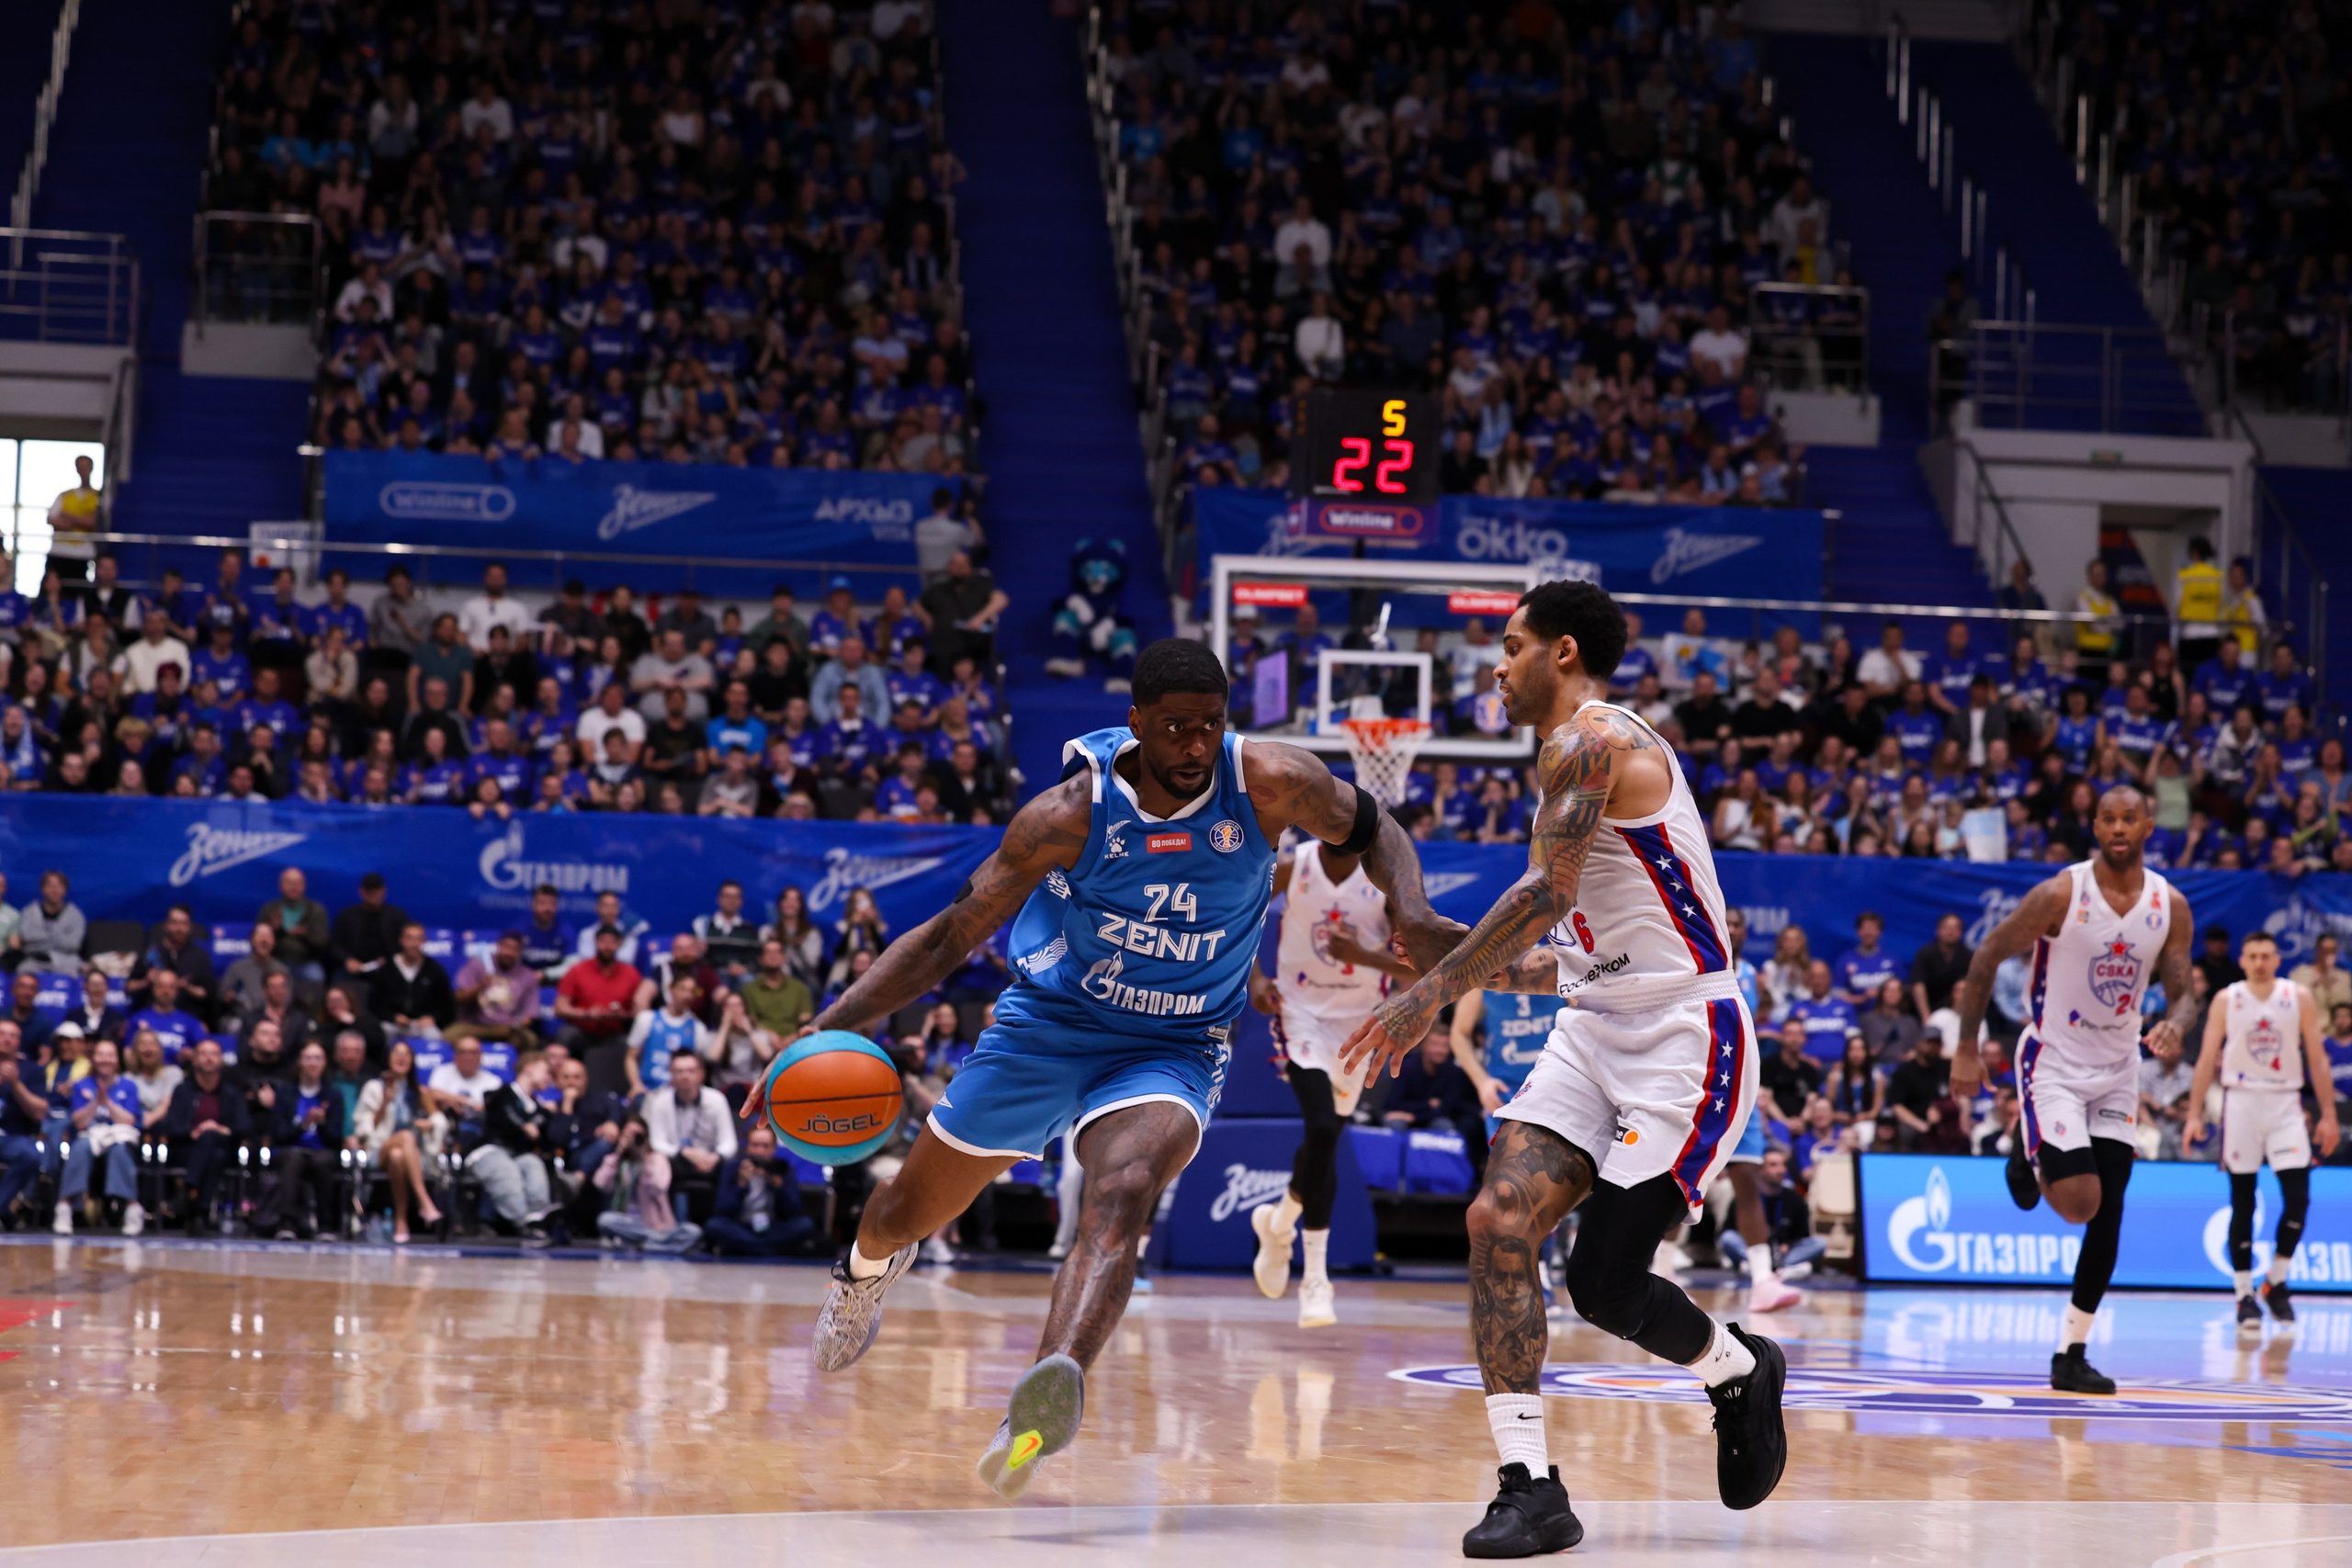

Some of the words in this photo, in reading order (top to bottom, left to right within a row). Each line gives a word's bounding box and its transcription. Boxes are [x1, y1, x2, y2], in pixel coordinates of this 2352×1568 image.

[1333, 437, 1414, 493] 22
[1103, 851, 1130, 860] KELME
[1151, 840, 1161, 849] 80
[1144, 883, 1197, 923] 24
[1097, 911, 1227, 962] ZENIT
[1573, 910, 1595, 954] 6
[2097, 964, 2134, 977] CSKA
[1112, 982, 1207, 1016] ГАЗПРОМ
[797, 1113, 883, 1134] JÖGEL
[1958, 1234, 2083, 1275] ГАЗПРО
